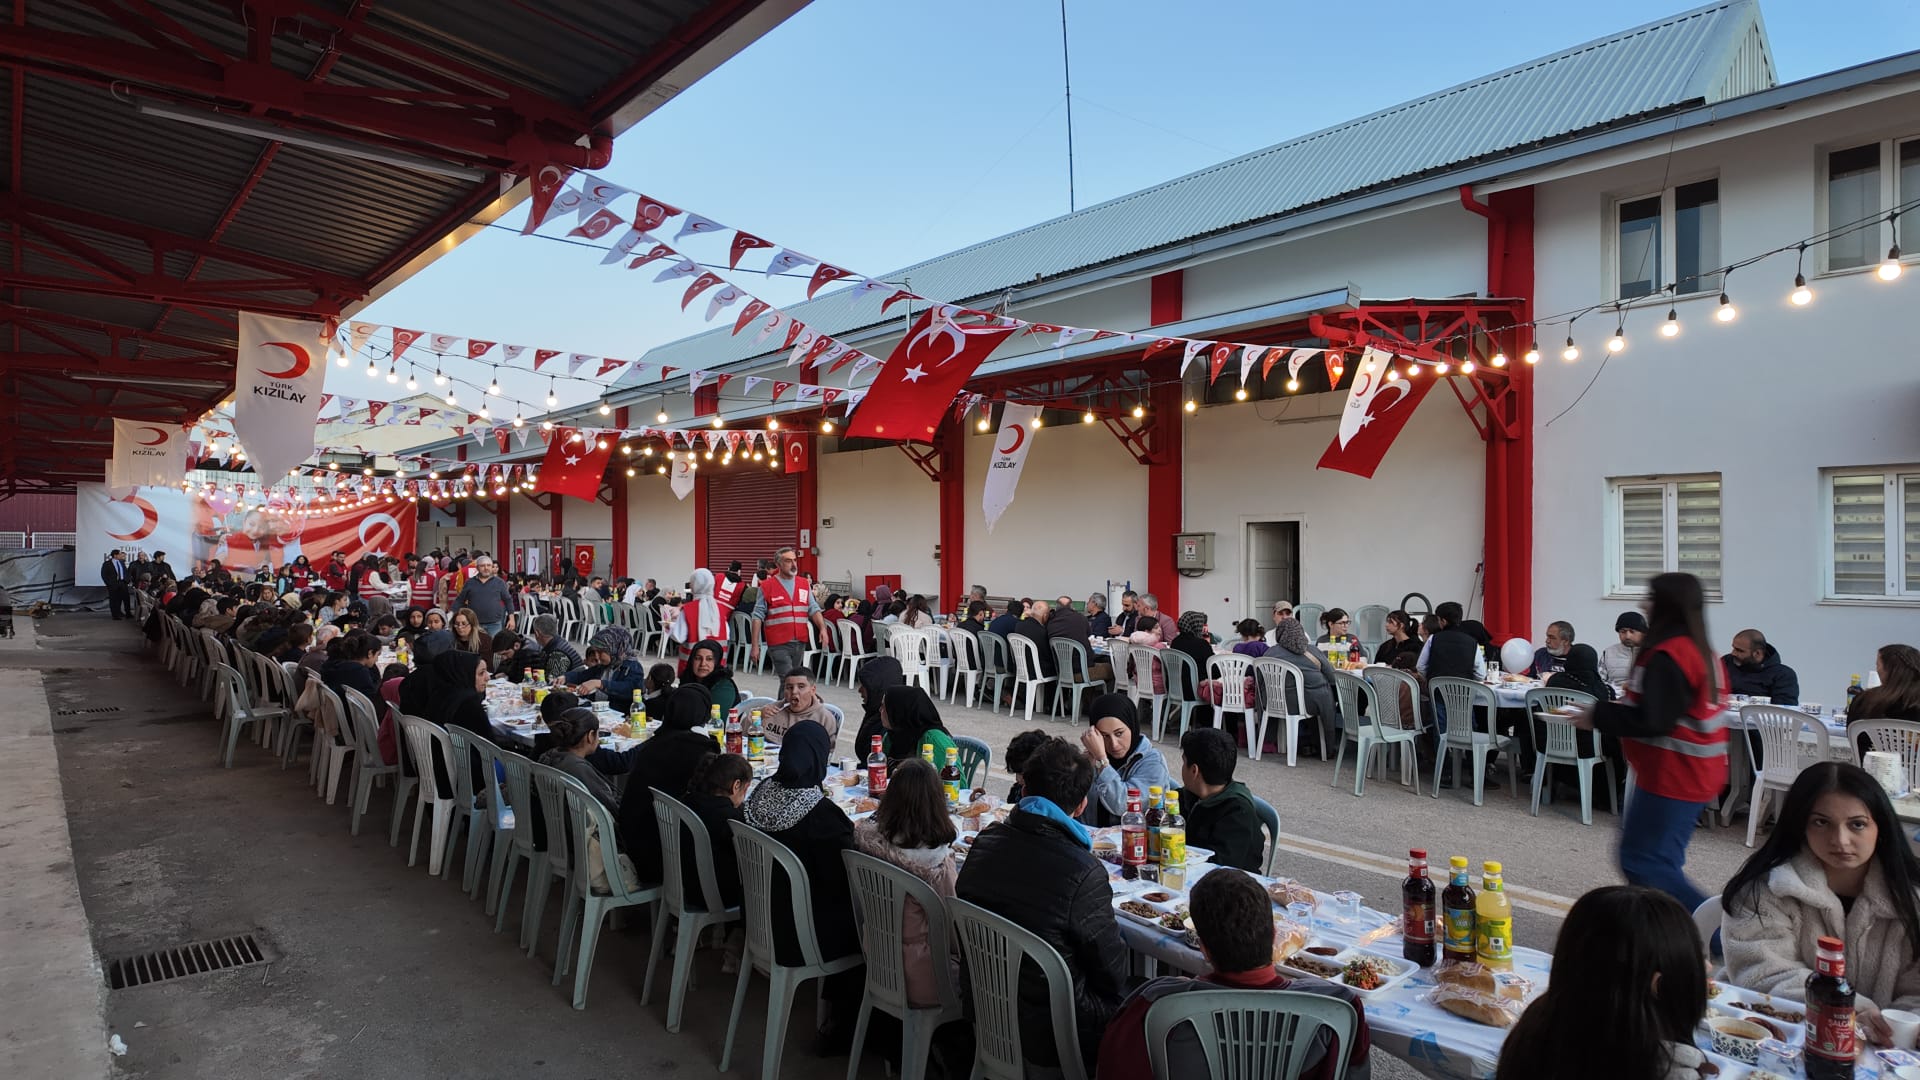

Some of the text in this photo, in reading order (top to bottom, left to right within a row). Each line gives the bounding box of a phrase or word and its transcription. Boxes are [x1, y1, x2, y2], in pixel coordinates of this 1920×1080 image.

[270, 381, 293, 391] TÜRK
[253, 386, 306, 404] KIZILAY
[766, 722, 788, 737] SALT
